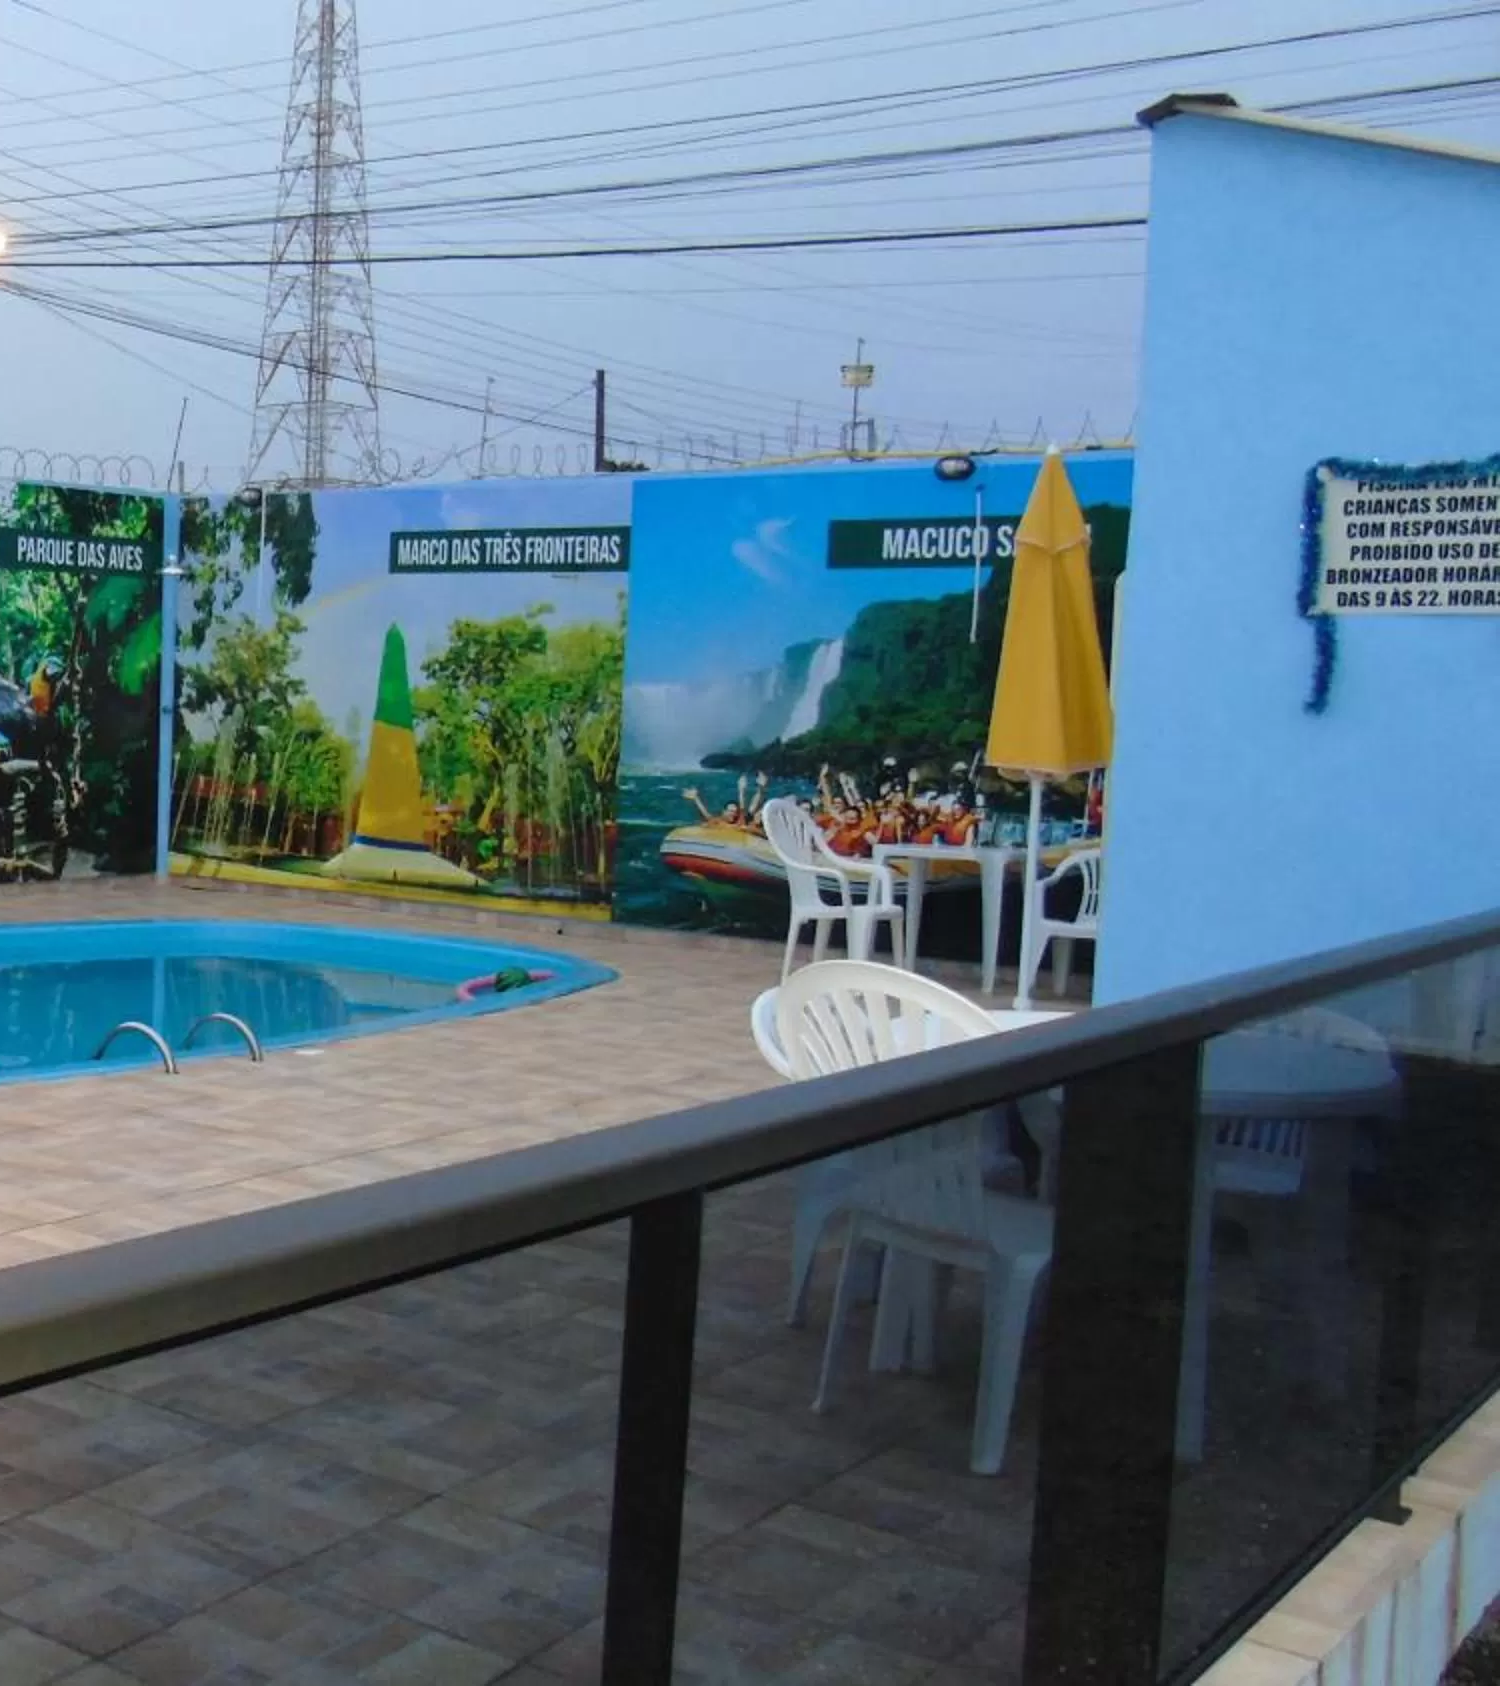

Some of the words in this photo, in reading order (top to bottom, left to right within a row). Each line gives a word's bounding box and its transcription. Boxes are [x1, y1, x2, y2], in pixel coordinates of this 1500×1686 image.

[1435, 495, 1500, 514] SOMEN
[1346, 521, 1385, 539] COM
[397, 538, 448, 566] MARCO
[451, 538, 481, 565] DAS
[484, 531, 521, 564] TRÊS
[524, 535, 621, 564] FRONTEIRAS
[881, 525, 989, 560] MACUCO
[1349, 543, 1433, 561] PROIBIDO
[1437, 543, 1474, 560] USO
[17, 535, 75, 566] PARQUE
[77, 541, 105, 569] DAS
[108, 544, 143, 571] AVES
[1326, 566, 1438, 585] BRONZEADOR
[1336, 591, 1371, 607] DAS
[1374, 591, 1387, 607] 9
